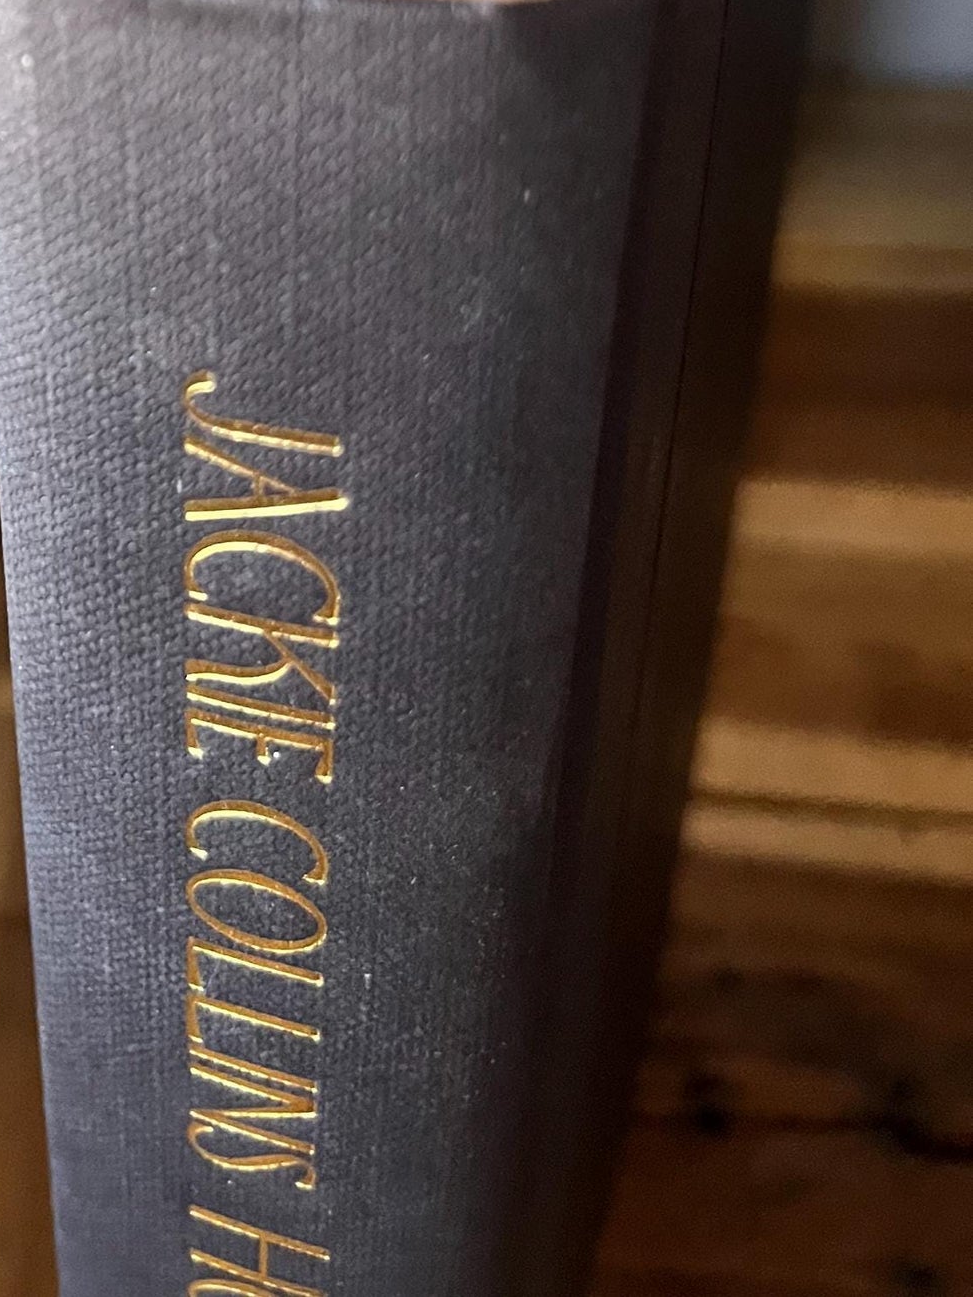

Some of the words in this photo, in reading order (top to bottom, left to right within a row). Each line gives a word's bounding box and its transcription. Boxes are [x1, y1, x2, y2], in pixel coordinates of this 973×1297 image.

[185, 369, 349, 784] JACKIE
[185, 798, 330, 1190] COLLINS
[188, 1204, 330, 1297] H
